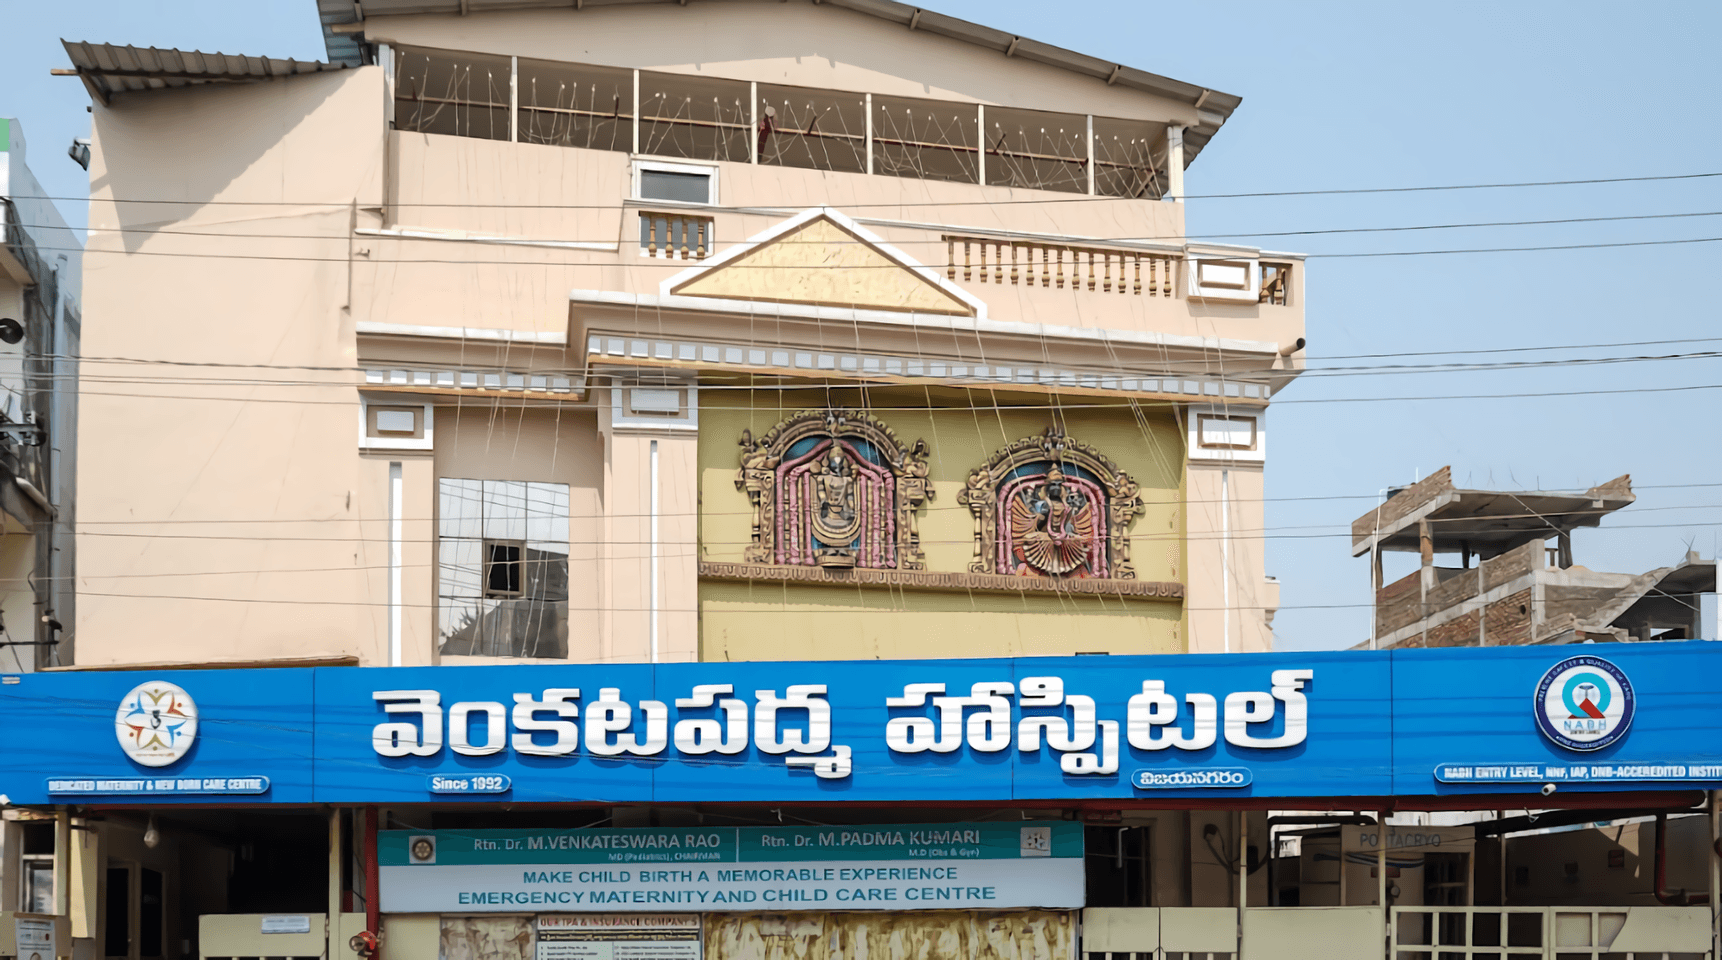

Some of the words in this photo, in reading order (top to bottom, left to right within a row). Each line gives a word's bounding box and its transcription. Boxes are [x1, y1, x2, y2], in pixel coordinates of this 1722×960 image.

[372, 684, 852, 779] వెంకటపద్మ
[886, 669, 1313, 775] హాస్పిటల్
[1140, 771, 1244, 785] విజయనగరం
[1475, 766, 1508, 779] ENTRY
[1510, 765, 1543, 780] LEVEL,
[1570, 765, 1589, 780] IAP,
[96, 780, 145, 791] MATERNITY
[146, 780, 153, 790] &
[203, 779, 227, 790] CARE
[227, 778, 262, 790] CENTRE
[432, 775, 469, 790] Since
[471, 775, 503, 790] 1992
[474, 838, 501, 851] Rtn.
[505, 838, 523, 850] Dr.
[527, 834, 680, 850] M.VENKATESWARA
[684, 833, 721, 848] RAO
[761, 834, 790, 847] Rtn.
[794, 834, 814, 847] Dr.
[818, 831, 905, 847] M.PADMA
[909, 830, 980, 845] KUMARI
[1360, 833, 1441, 848] POTACRYO
[523, 871, 572, 884] MAKE
[578, 871, 632, 884] CHILD
[639, 870, 692, 883] BIRTH
[697, 870, 710, 883] A
[717, 869, 835, 883] MEMORABLE
[839, 867, 958, 881] EXPERIENCE
[458, 890, 585, 905] EMERGENCY
[589, 890, 710, 904] MATERNITY
[712, 890, 757, 903] AND
[762, 888, 829, 903] CHILD
[835, 888, 898, 902] CARE
[904, 886, 996, 901] CENTRE
